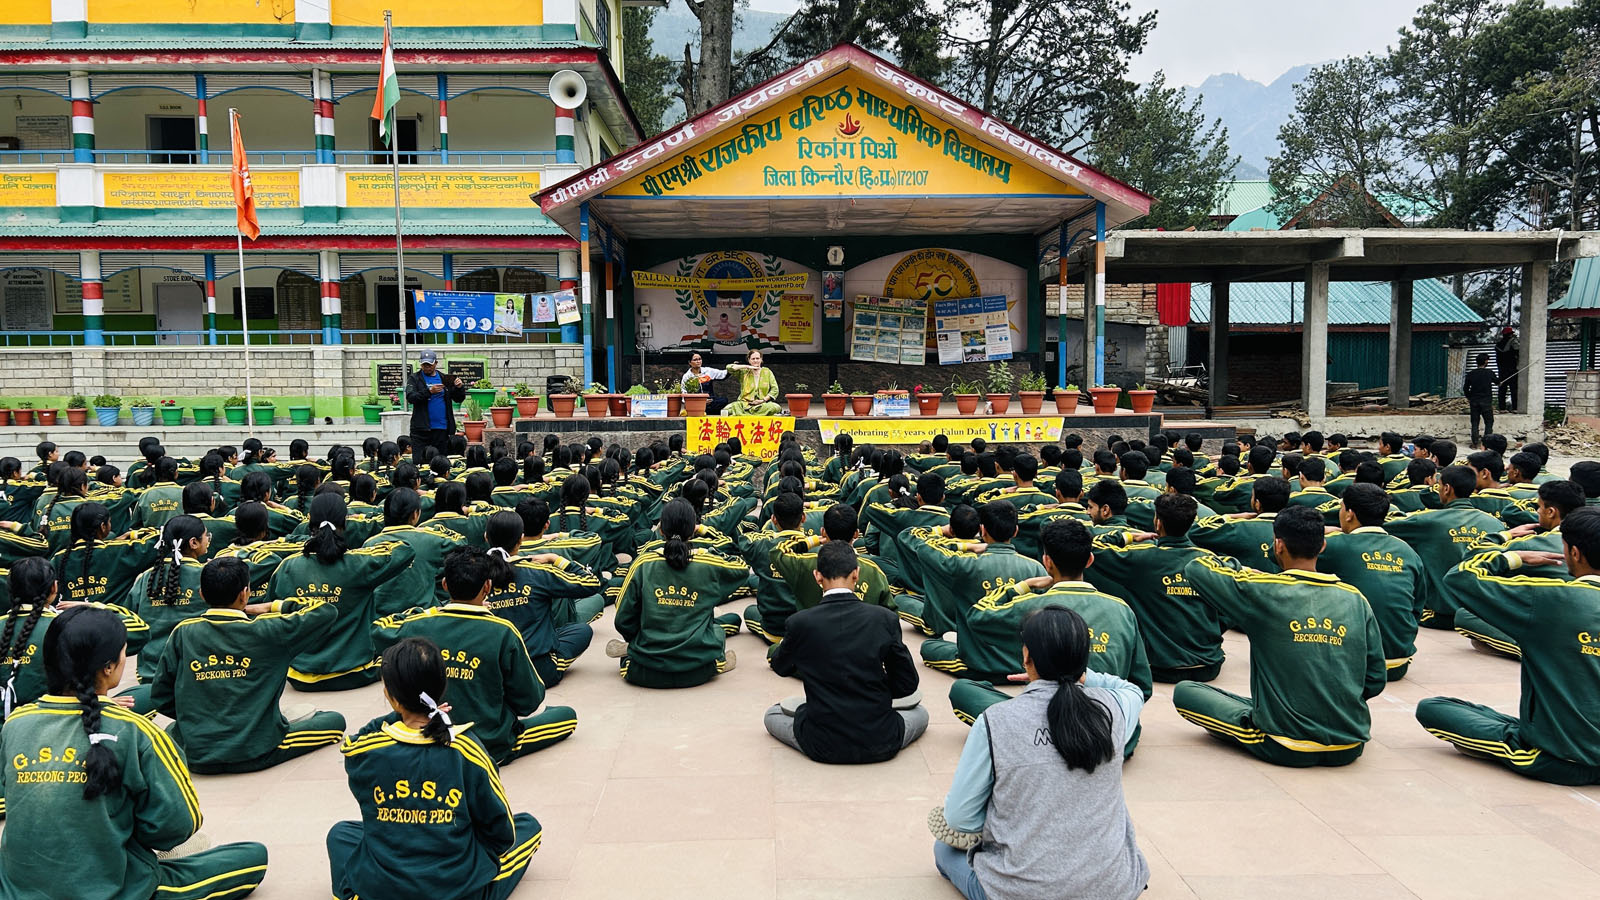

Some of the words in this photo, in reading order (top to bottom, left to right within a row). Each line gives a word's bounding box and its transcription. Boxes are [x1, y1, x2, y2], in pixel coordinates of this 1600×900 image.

[614, 123, 696, 172] स्वर्ण
[715, 59, 825, 122] जयन्ती
[700, 116, 782, 173] राजकीय
[789, 84, 853, 131] वरिष्ठ
[857, 87, 941, 149] माध्यमिक
[944, 129, 1013, 184] विद्यालय
[797, 137, 855, 160] रिकांग
[859, 137, 898, 160] पिओ
[980, 116, 1083, 177] विद्यालय
[763, 166, 797, 187] जिला
[801, 163, 853, 187] किन्नौर
[705, 253, 723, 266] SR.
[723, 251, 744, 262] SEC.
[637, 272, 671, 282] FALUN
[674, 276, 700, 284] DAFA
[698, 418, 783, 446] 法輪大法好
[840, 428, 889, 439] Celebrating
[904, 430, 926, 439] years
[928, 428, 937, 436] of
[941, 428, 963, 436] Falun
[967, 428, 987, 436] Dafa
[698, 445, 713, 453] Falu
[761, 448, 778, 458] Goo
[1361, 551, 1403, 566] G.S.S.S
[296, 583, 342, 597] G.S.S.S
[655, 585, 698, 601] G.S.S.S
[1166, 586, 1192, 596] RECKONG
[515, 596, 529, 606] PEO
[1289, 617, 1347, 638] G.S.S.S
[1293, 633, 1328, 643] RECKONG
[1329, 636, 1343, 646] PEO
[190, 654, 251, 672] G.S.S.S
[195, 671, 230, 681] RECKONG
[232, 669, 247, 678] PEO
[459, 668, 474, 681] PEO
[16, 771, 65, 783] RECKONG
[373, 780, 462, 808] G.S.S.S
[376, 807, 427, 823] RECKONG
[428, 808, 453, 824] PEO
